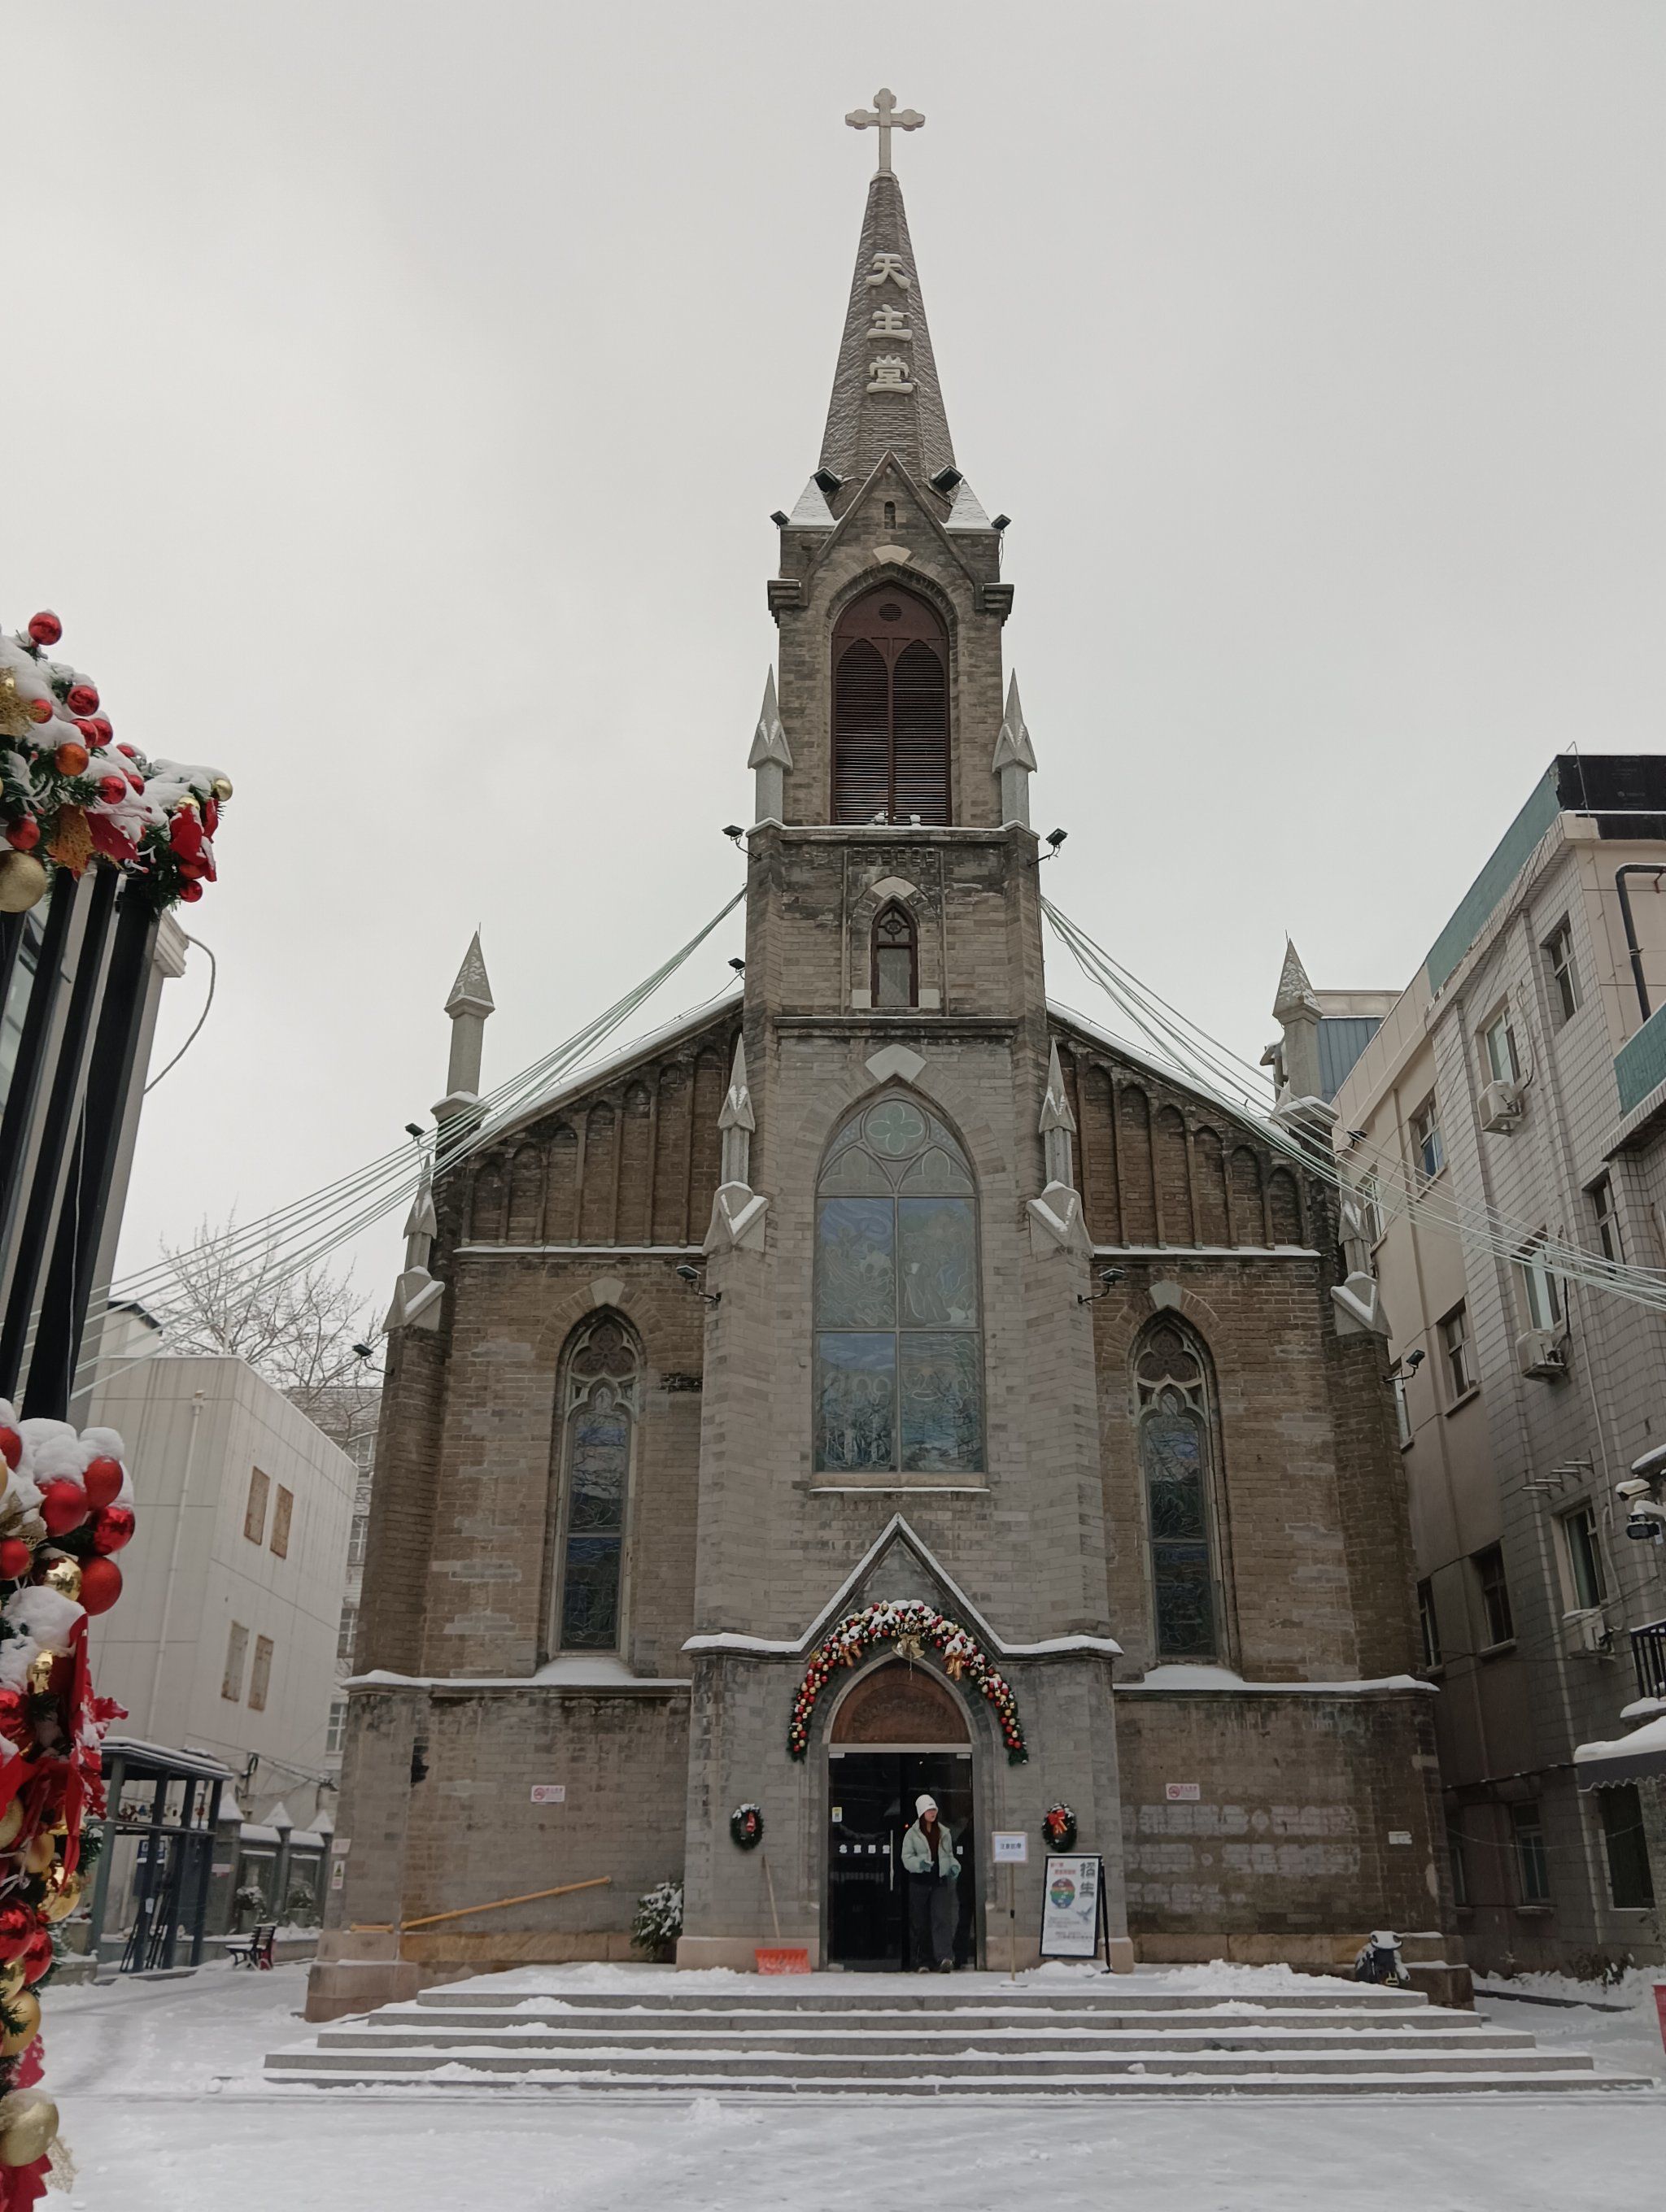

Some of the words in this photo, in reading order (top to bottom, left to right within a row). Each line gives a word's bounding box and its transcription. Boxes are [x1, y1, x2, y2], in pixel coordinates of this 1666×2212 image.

[866, 253, 914, 394] 天主堂
[1079, 1861, 1096, 1897] 招生
